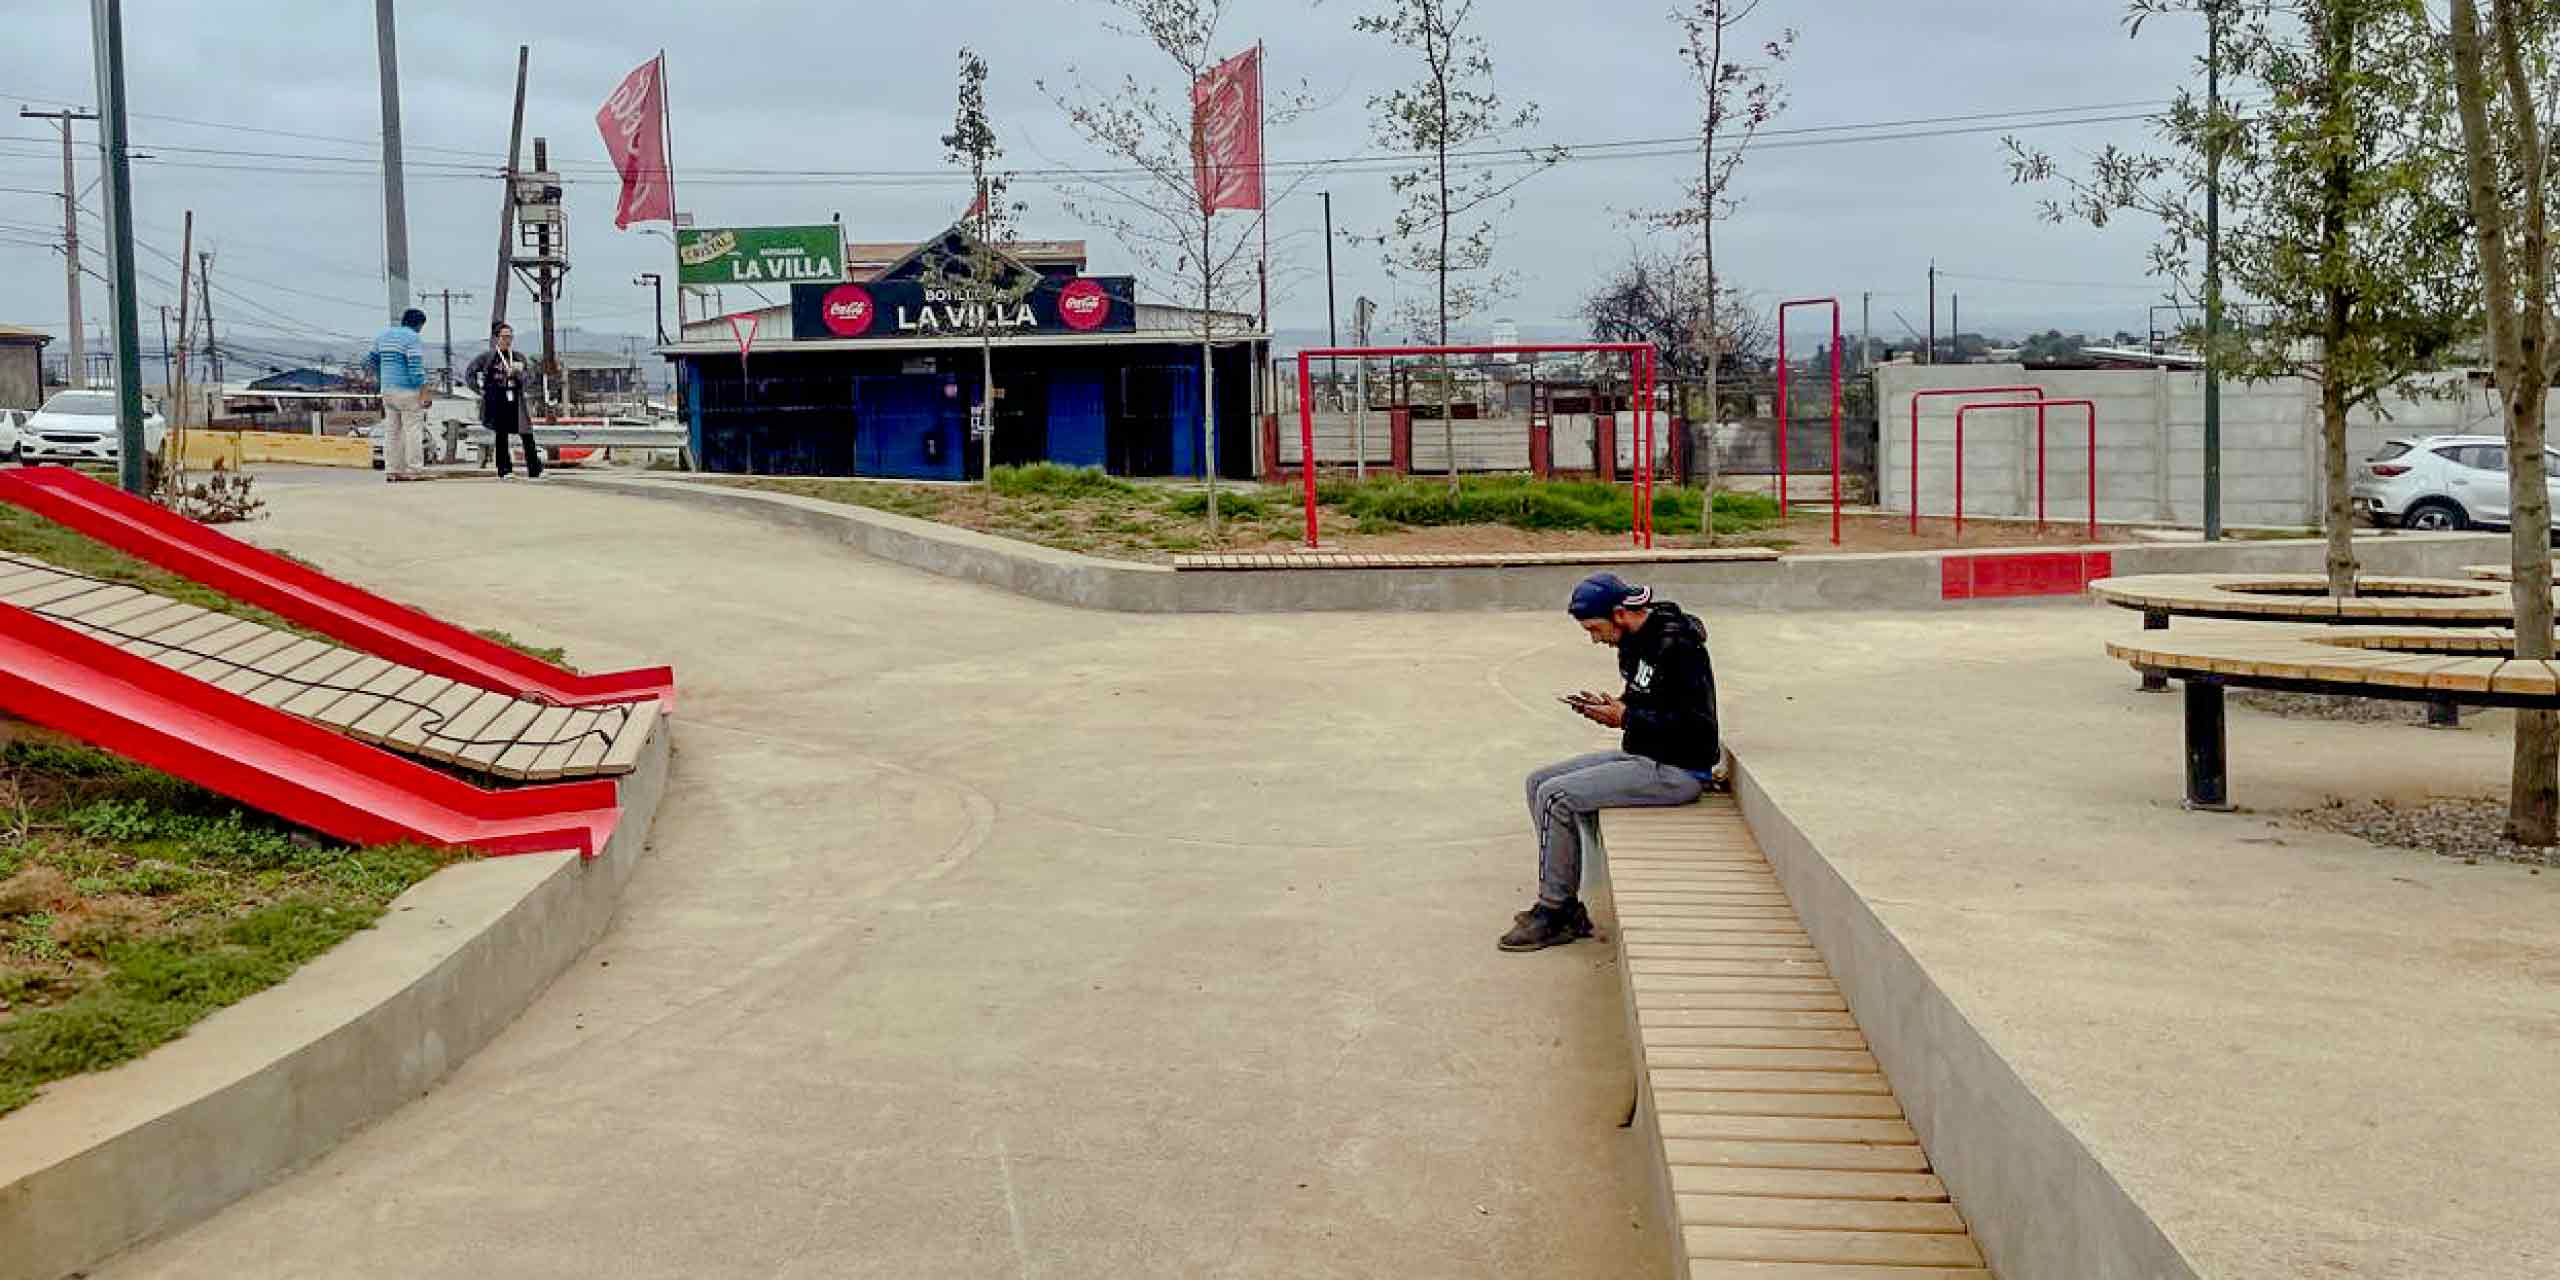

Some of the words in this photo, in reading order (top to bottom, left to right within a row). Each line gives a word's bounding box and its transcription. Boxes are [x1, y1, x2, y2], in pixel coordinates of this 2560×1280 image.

[732, 259, 762, 280] LA
[767, 256, 835, 278] VILLA
[898, 305, 939, 329] LA
[944, 303, 1038, 328] VILLA
